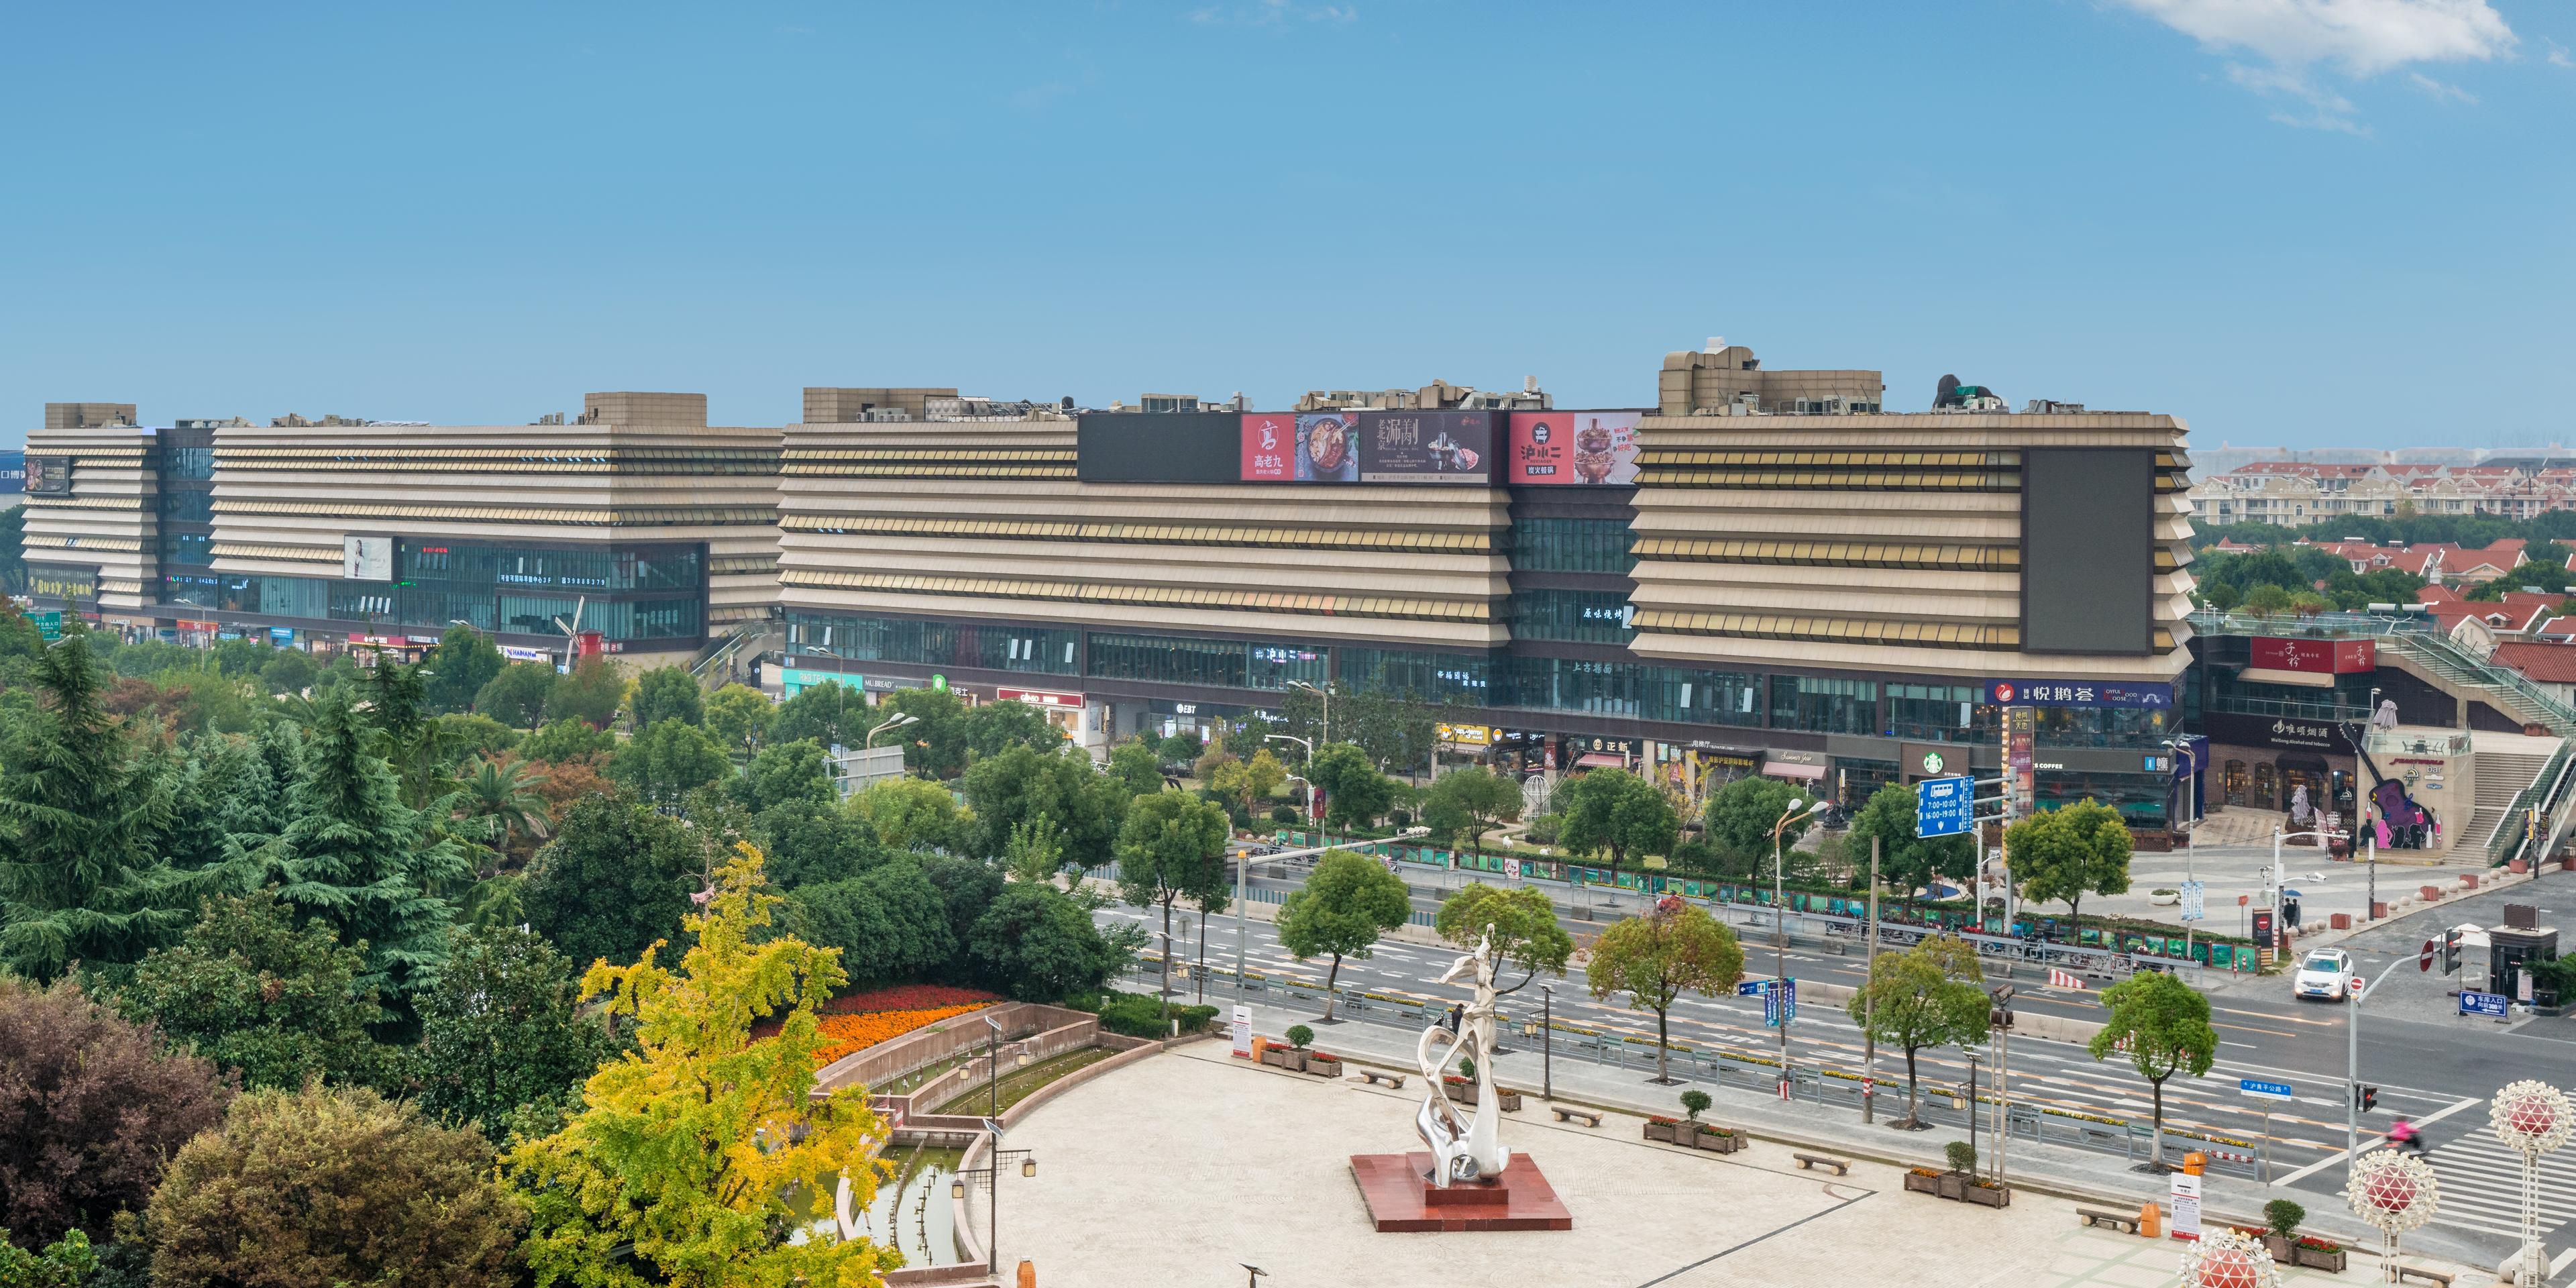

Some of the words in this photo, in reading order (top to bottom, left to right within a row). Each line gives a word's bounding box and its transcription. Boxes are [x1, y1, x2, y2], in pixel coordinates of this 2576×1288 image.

[1254, 454, 1283, 468] 高老九
[1584, 608, 1622, 620] 原味烧烤
[2033, 686, 2094, 702] 悦鹅荟
[1183, 705, 1196, 714] EBT
[2286, 724, 2328, 738] 唯颂烟酒
[1607, 741, 1628, 752] 正新
[1692, 740, 1711, 749] 电梯厅
[1927, 799, 1957, 809] 7:00-10:00
[1925, 809, 1956, 820] 16:00-19:00
[2477, 996, 2503, 1004] 车库入口
[2250, 1083, 2282, 1093] 沪青平公路
